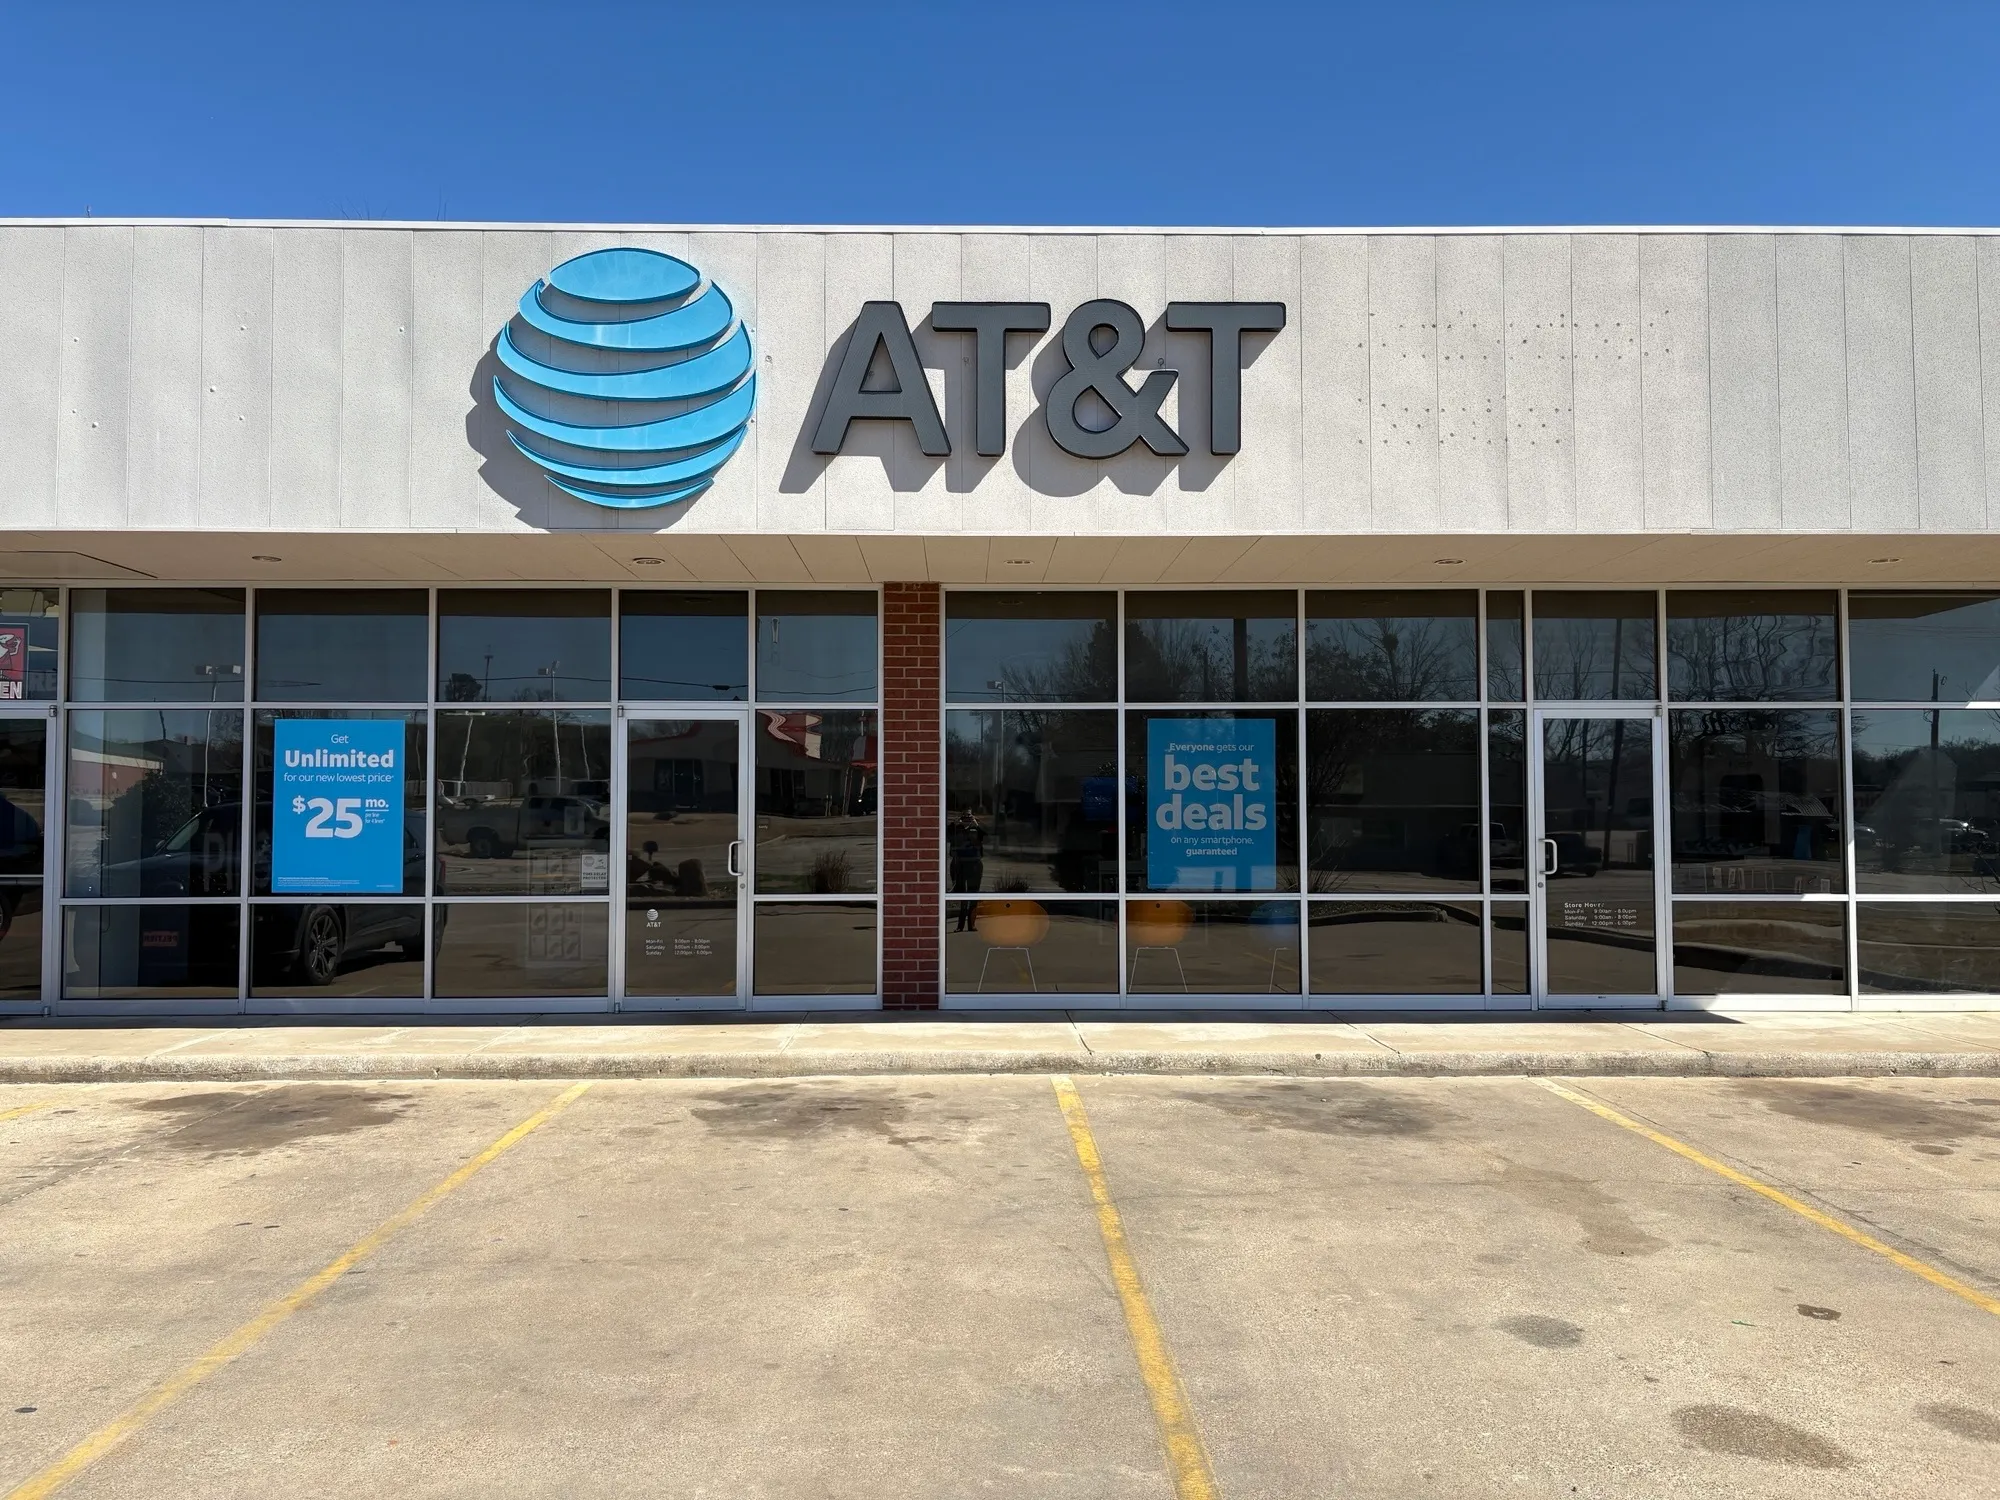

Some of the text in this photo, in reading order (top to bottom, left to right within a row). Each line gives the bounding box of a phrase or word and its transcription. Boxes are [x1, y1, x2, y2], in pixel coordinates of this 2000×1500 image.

[812, 299, 1287, 459] AT&T
[331, 734, 349, 744] Get
[1169, 743, 1214, 753] Everyone
[1216, 743, 1236, 753] gets
[285, 749, 394, 768] Unlimited
[283, 772, 297, 782] for
[298, 774, 314, 782] our
[316, 774, 334, 782] new
[336, 772, 366, 782] lowest
[1164, 754, 1260, 791] best
[292, 795, 389, 838] $25 mo.
[1156, 793, 1267, 831] deals
[1170, 836, 1182, 844] on
[1183, 836, 1198, 846] any
[1186, 847, 1237, 857] guaranteed
